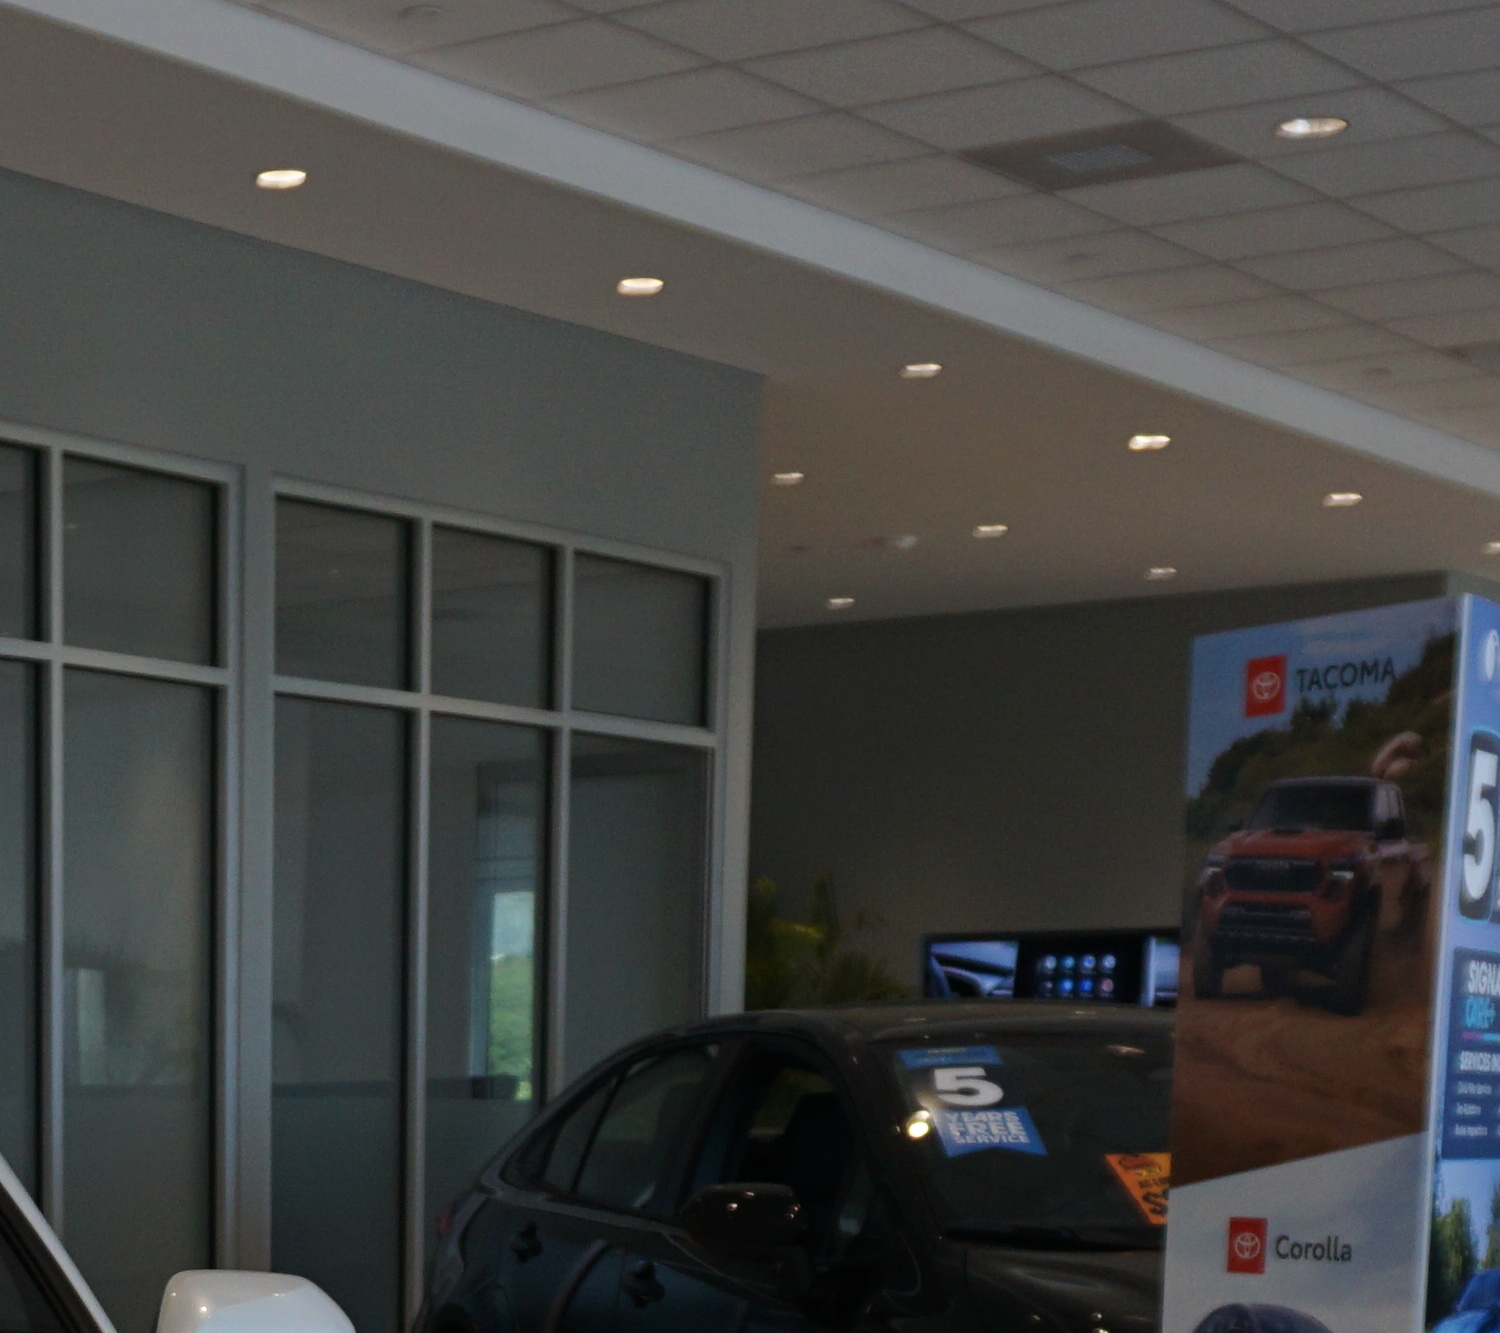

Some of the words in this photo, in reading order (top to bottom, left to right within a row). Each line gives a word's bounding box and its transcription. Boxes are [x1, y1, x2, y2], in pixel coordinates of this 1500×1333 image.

[1296, 658, 1397, 692] TACOMA
[1463, 749, 1499, 900] 5
[934, 1067, 1004, 1106] 5
[950, 1121, 1025, 1135] FREE
[954, 1134, 1030, 1143] SERVICE
[1275, 1235, 1352, 1263] Corolla
